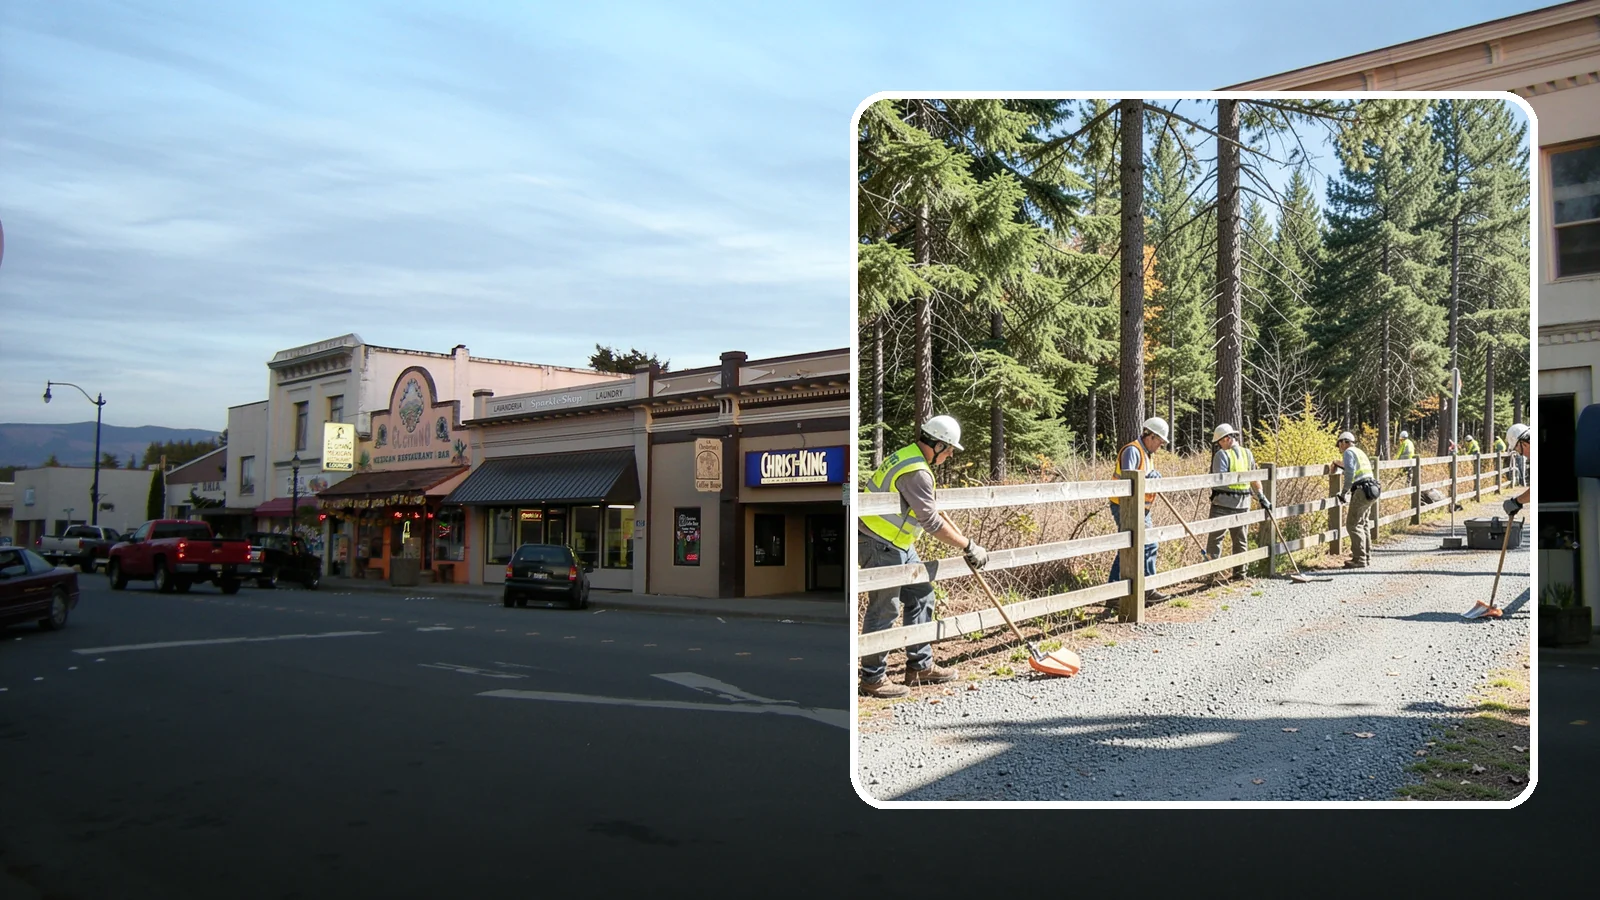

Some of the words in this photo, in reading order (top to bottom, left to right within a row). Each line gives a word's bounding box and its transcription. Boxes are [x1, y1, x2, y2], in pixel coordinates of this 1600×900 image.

[493, 402, 522, 412] LAVANDERIA
[530, 398, 559, 408] Sparkle
[561, 395, 583, 407] Shop
[595, 389, 623, 399] LAUNDRY
[398, 451, 433, 462] RESTAURANT
[438, 450, 450, 459] BAR
[761, 452, 797, 478] CHRIST
[799, 450, 827, 476] KING
